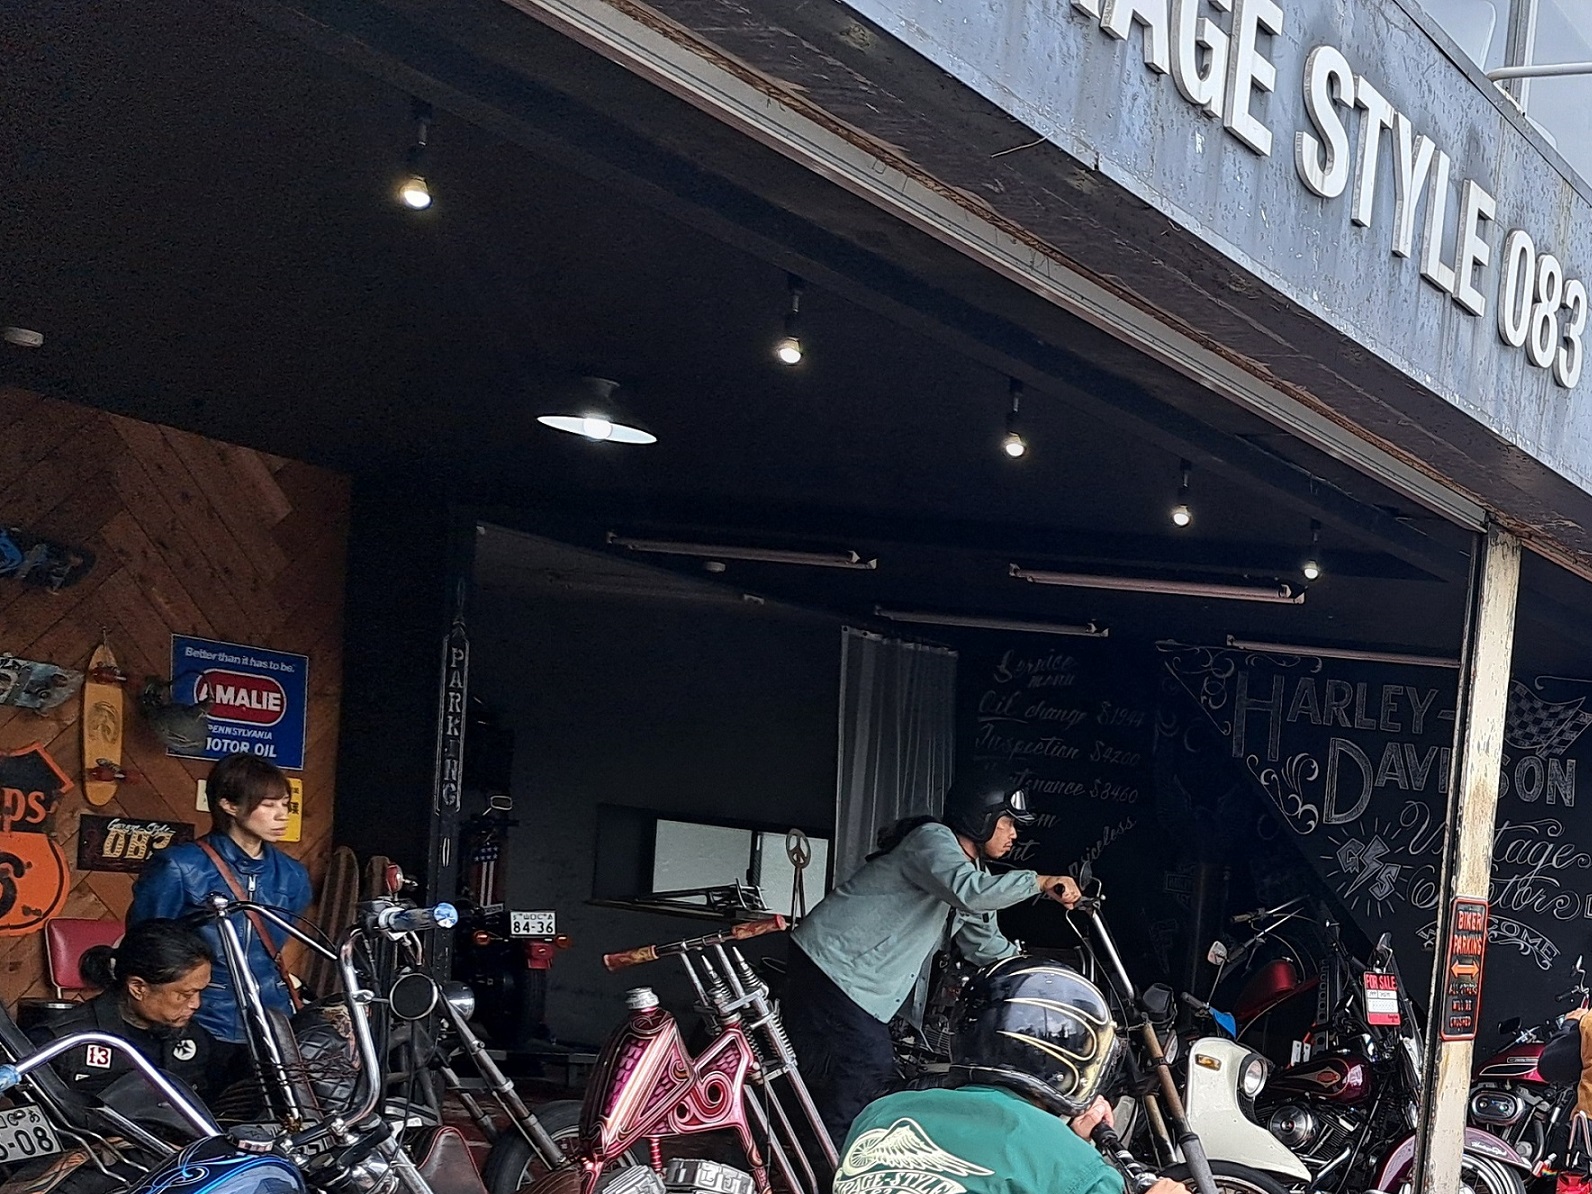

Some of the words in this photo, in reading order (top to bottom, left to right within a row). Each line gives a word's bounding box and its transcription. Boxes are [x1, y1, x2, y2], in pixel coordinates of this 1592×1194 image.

[1294, 45, 1497, 318] STYLE
[1497, 228, 1588, 389] 083
[218, 651, 241, 666] than
[206, 737, 251, 754] OTOR
[254, 742, 277, 763] OIL
[513, 921, 554, 934] 84-36
[1457, 910, 1483, 932] BIKER
[1366, 974, 1378, 989] FOR
[1379, 975, 1397, 990] SALE
[88, 1046, 109, 1065] 13
